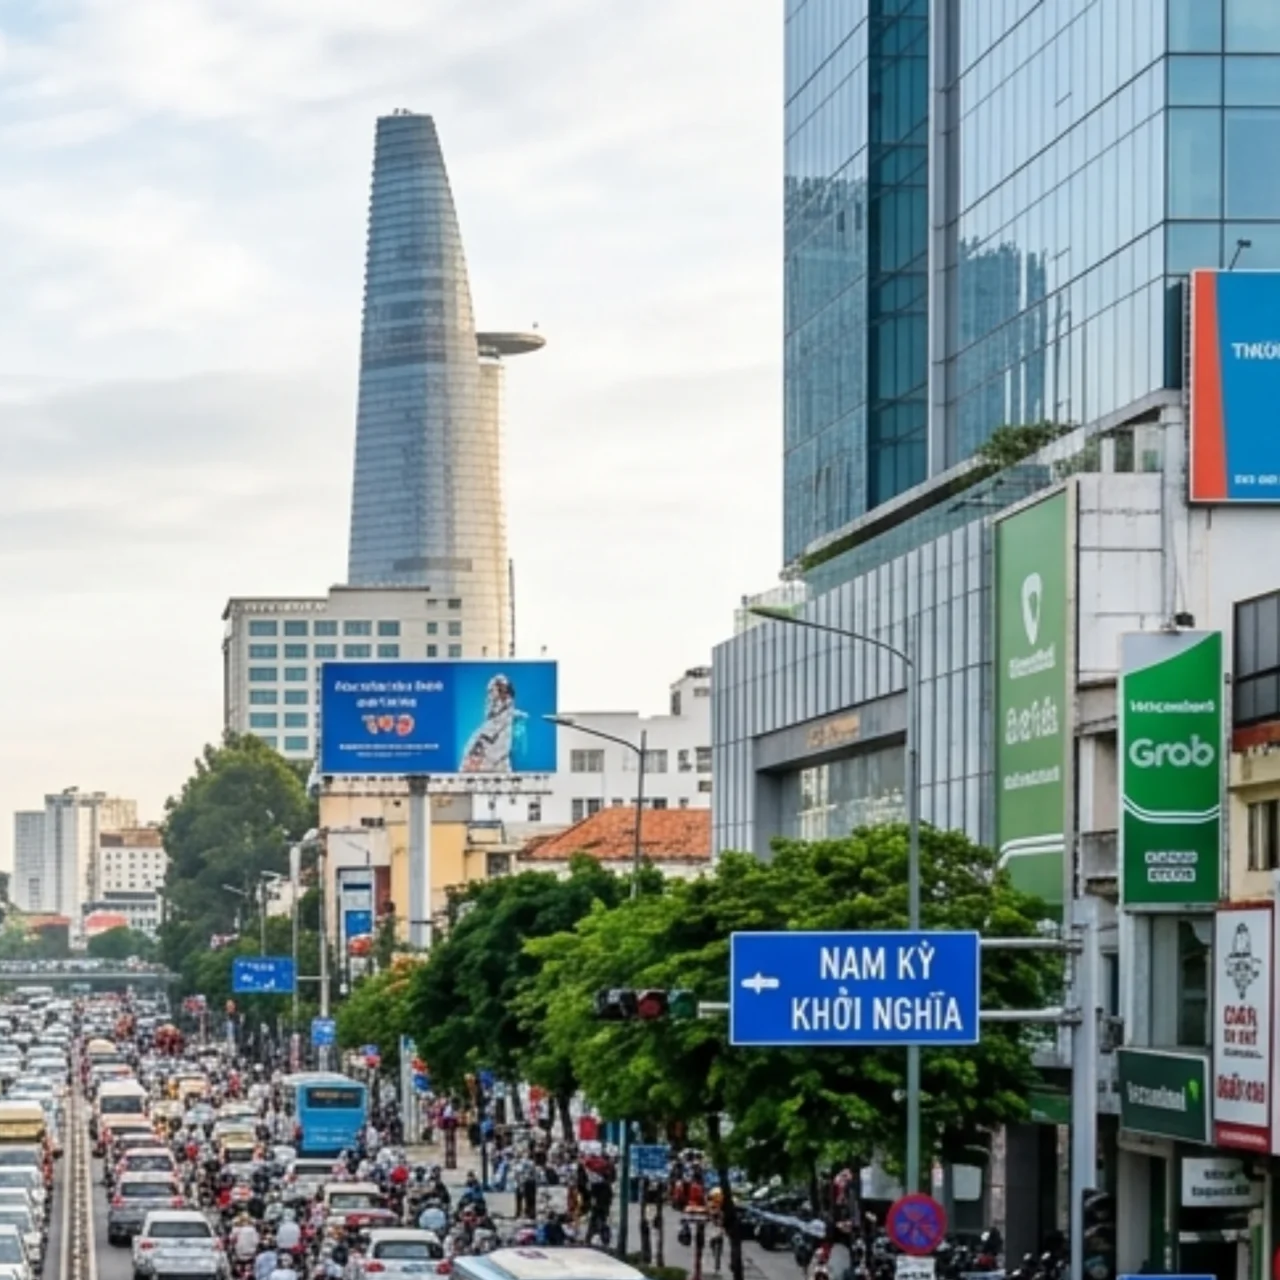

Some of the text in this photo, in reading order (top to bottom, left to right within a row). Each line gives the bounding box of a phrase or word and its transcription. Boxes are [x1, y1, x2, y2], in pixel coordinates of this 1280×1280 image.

[1129, 734, 1215, 767] Grab
[821, 946, 886, 980] NAM
[872, 990, 964, 1031] NGHĨA
